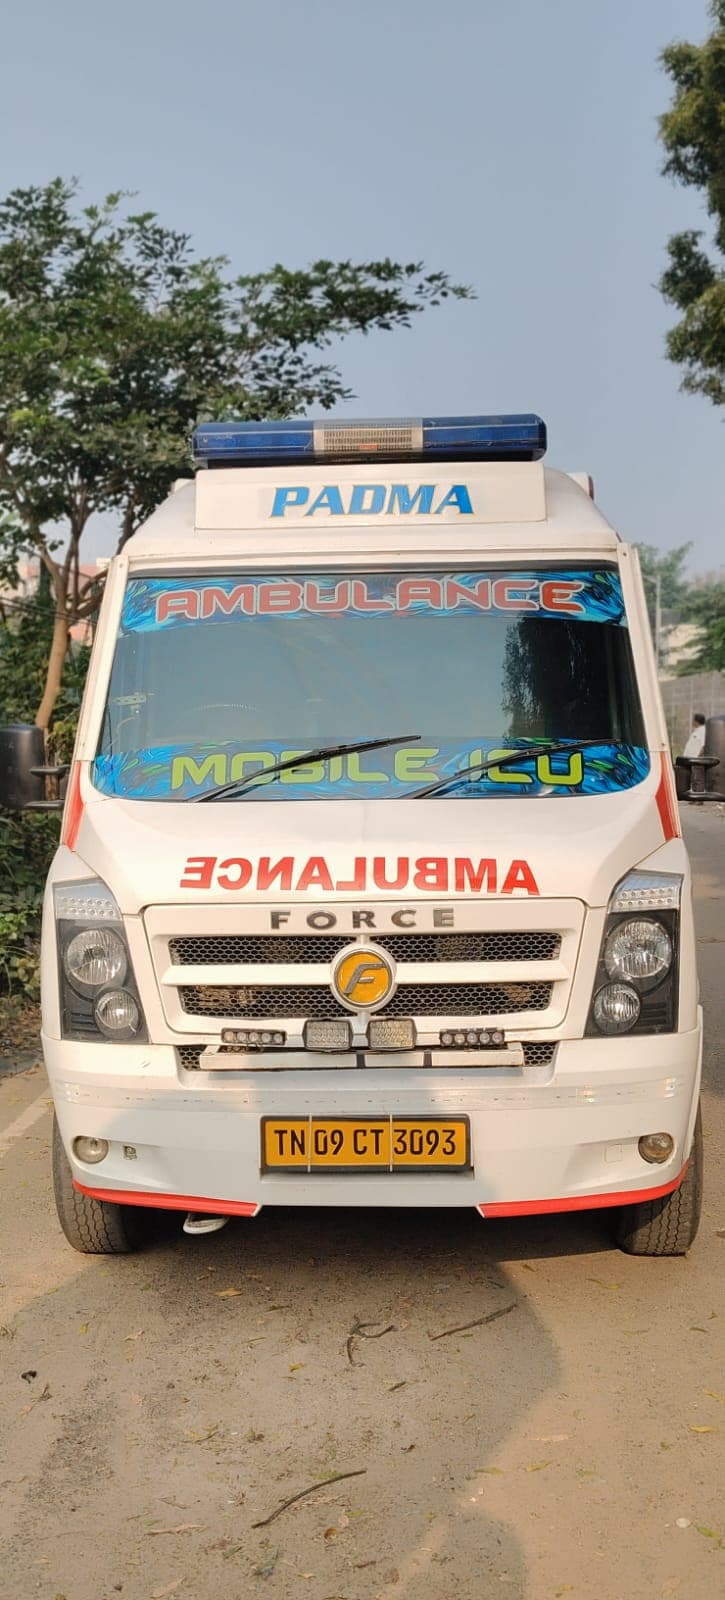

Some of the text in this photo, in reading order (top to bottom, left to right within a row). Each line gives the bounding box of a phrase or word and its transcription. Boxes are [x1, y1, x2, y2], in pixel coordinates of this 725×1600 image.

[271, 484, 474, 517] PADMA
[156, 579, 585, 622] AMBULANCE
[171, 748, 583, 790] MOBILE ICU
[270, 908, 455, 929] FORCE
[344, 962, 386, 994] F
[274, 1129, 456, 1156] TN 09 CT 3093
